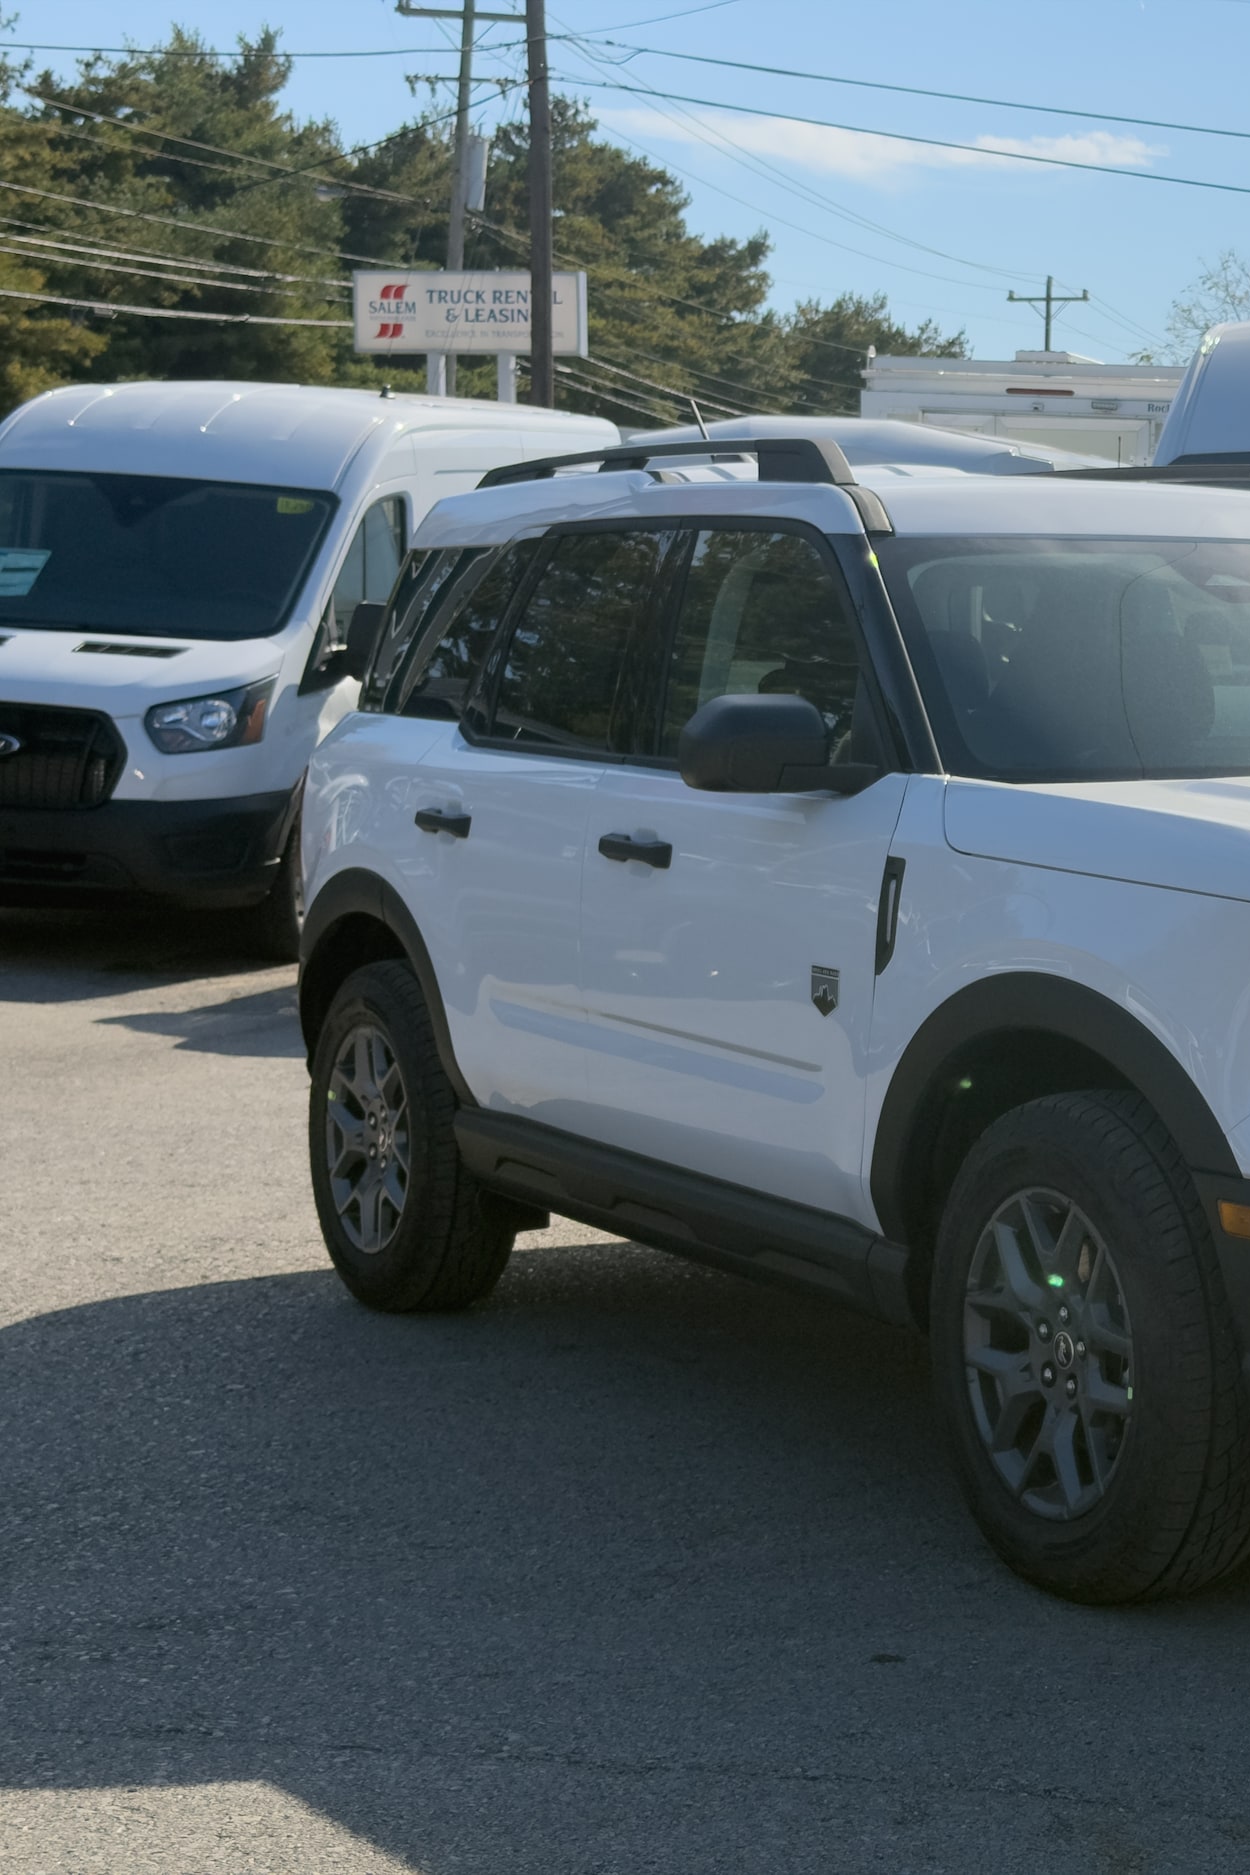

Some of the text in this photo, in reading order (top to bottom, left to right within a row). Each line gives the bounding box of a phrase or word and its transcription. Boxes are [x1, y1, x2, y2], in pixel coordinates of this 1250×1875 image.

[426, 289, 563, 304] TRUCK RENL
[368, 301, 416, 314] SALEM
[445, 308, 530, 323] & LEASIN
